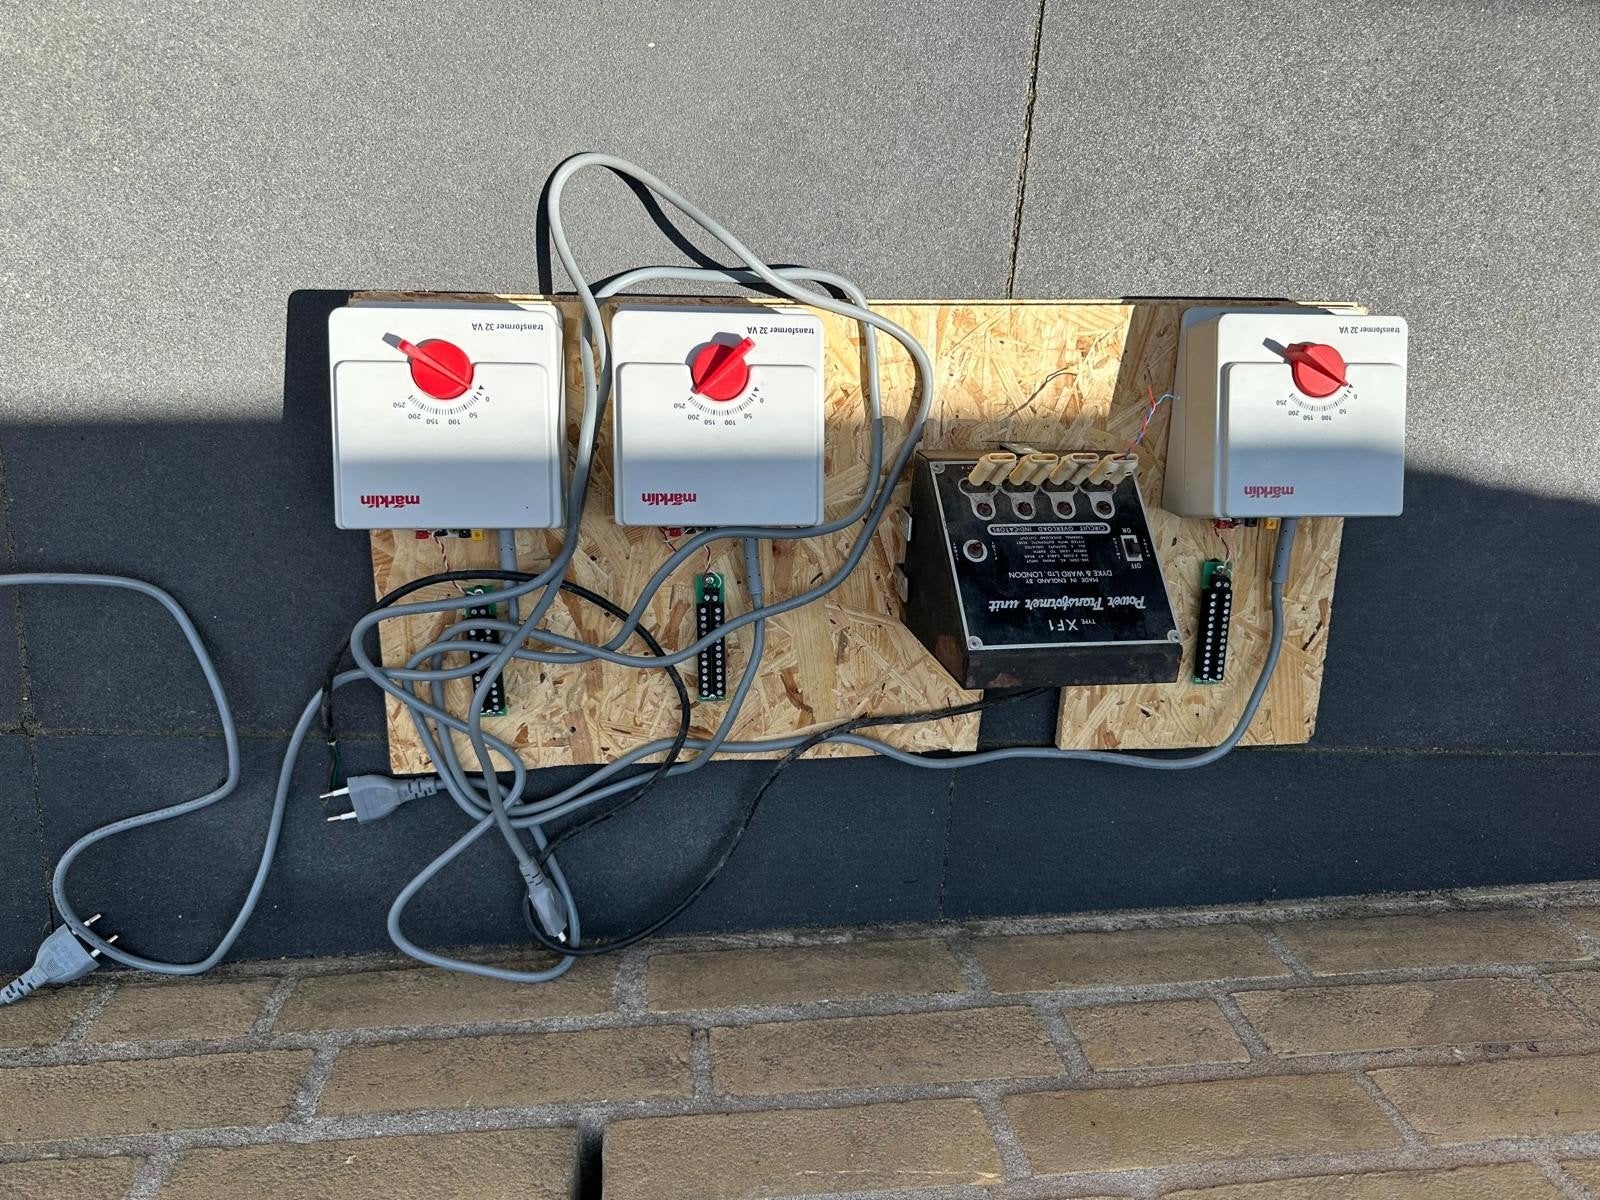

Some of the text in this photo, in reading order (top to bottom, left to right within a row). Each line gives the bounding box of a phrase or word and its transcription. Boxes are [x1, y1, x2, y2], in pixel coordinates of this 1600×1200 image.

[497, 323, 543, 331] transformer
[770, 327, 814, 335] transformer
[1093, 569, 1113, 577] DYKE
[988, 596, 1146, 612] Power Transformer unit
[1048, 619, 1078, 631] XF1
